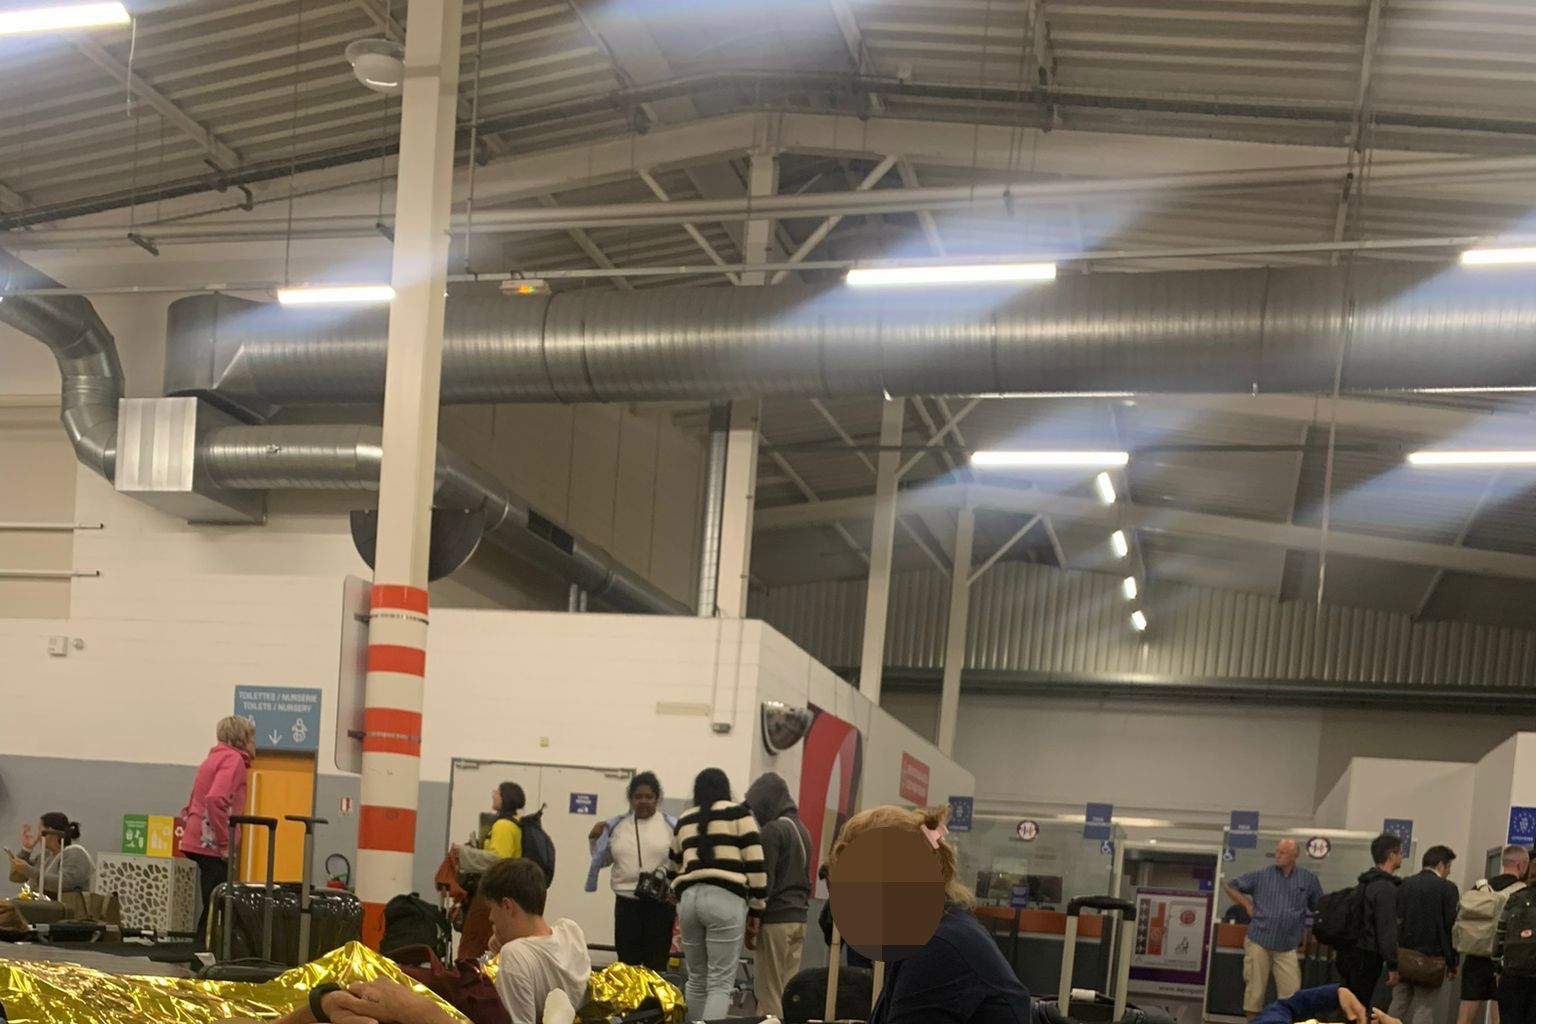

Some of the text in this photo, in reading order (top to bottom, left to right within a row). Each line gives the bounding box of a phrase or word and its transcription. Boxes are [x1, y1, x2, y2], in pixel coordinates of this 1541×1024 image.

[239, 691, 276, 702] TOILETTES
[281, 693, 318, 703] NURSERIE
[243, 701, 272, 711] TOILETS
[278, 703, 313, 713] NURSERY
